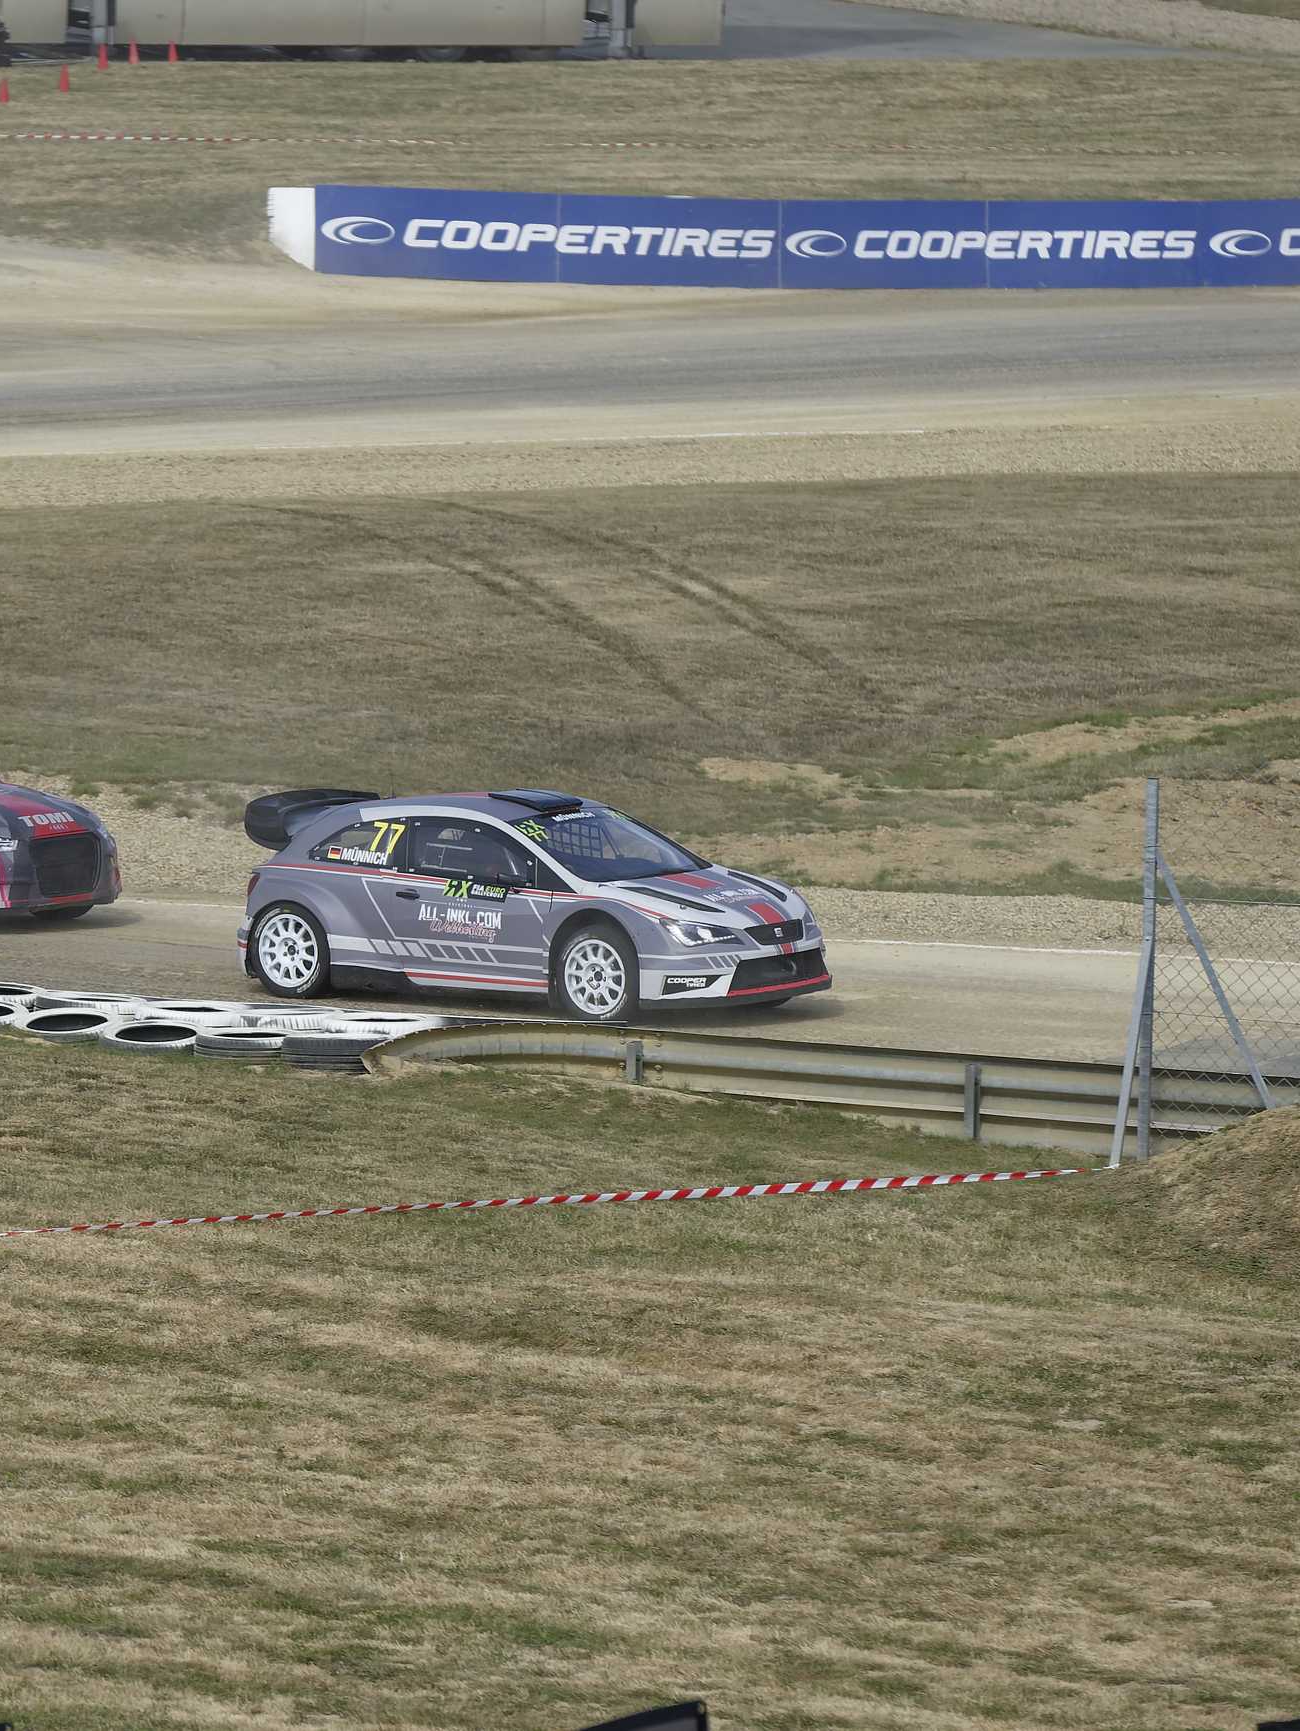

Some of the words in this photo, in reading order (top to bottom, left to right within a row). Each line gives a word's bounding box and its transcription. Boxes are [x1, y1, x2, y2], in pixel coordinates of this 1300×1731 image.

[17, 811, 75, 827] TOMI
[369, 821, 406, 855] 77
[341, 846, 389, 866] MÜNNICH
[472, 884, 485, 892] FIA
[484, 885, 506, 895] EURO
[418, 903, 502, 930] ALL-INKL.COM
[667, 977, 707, 985] COOPER
